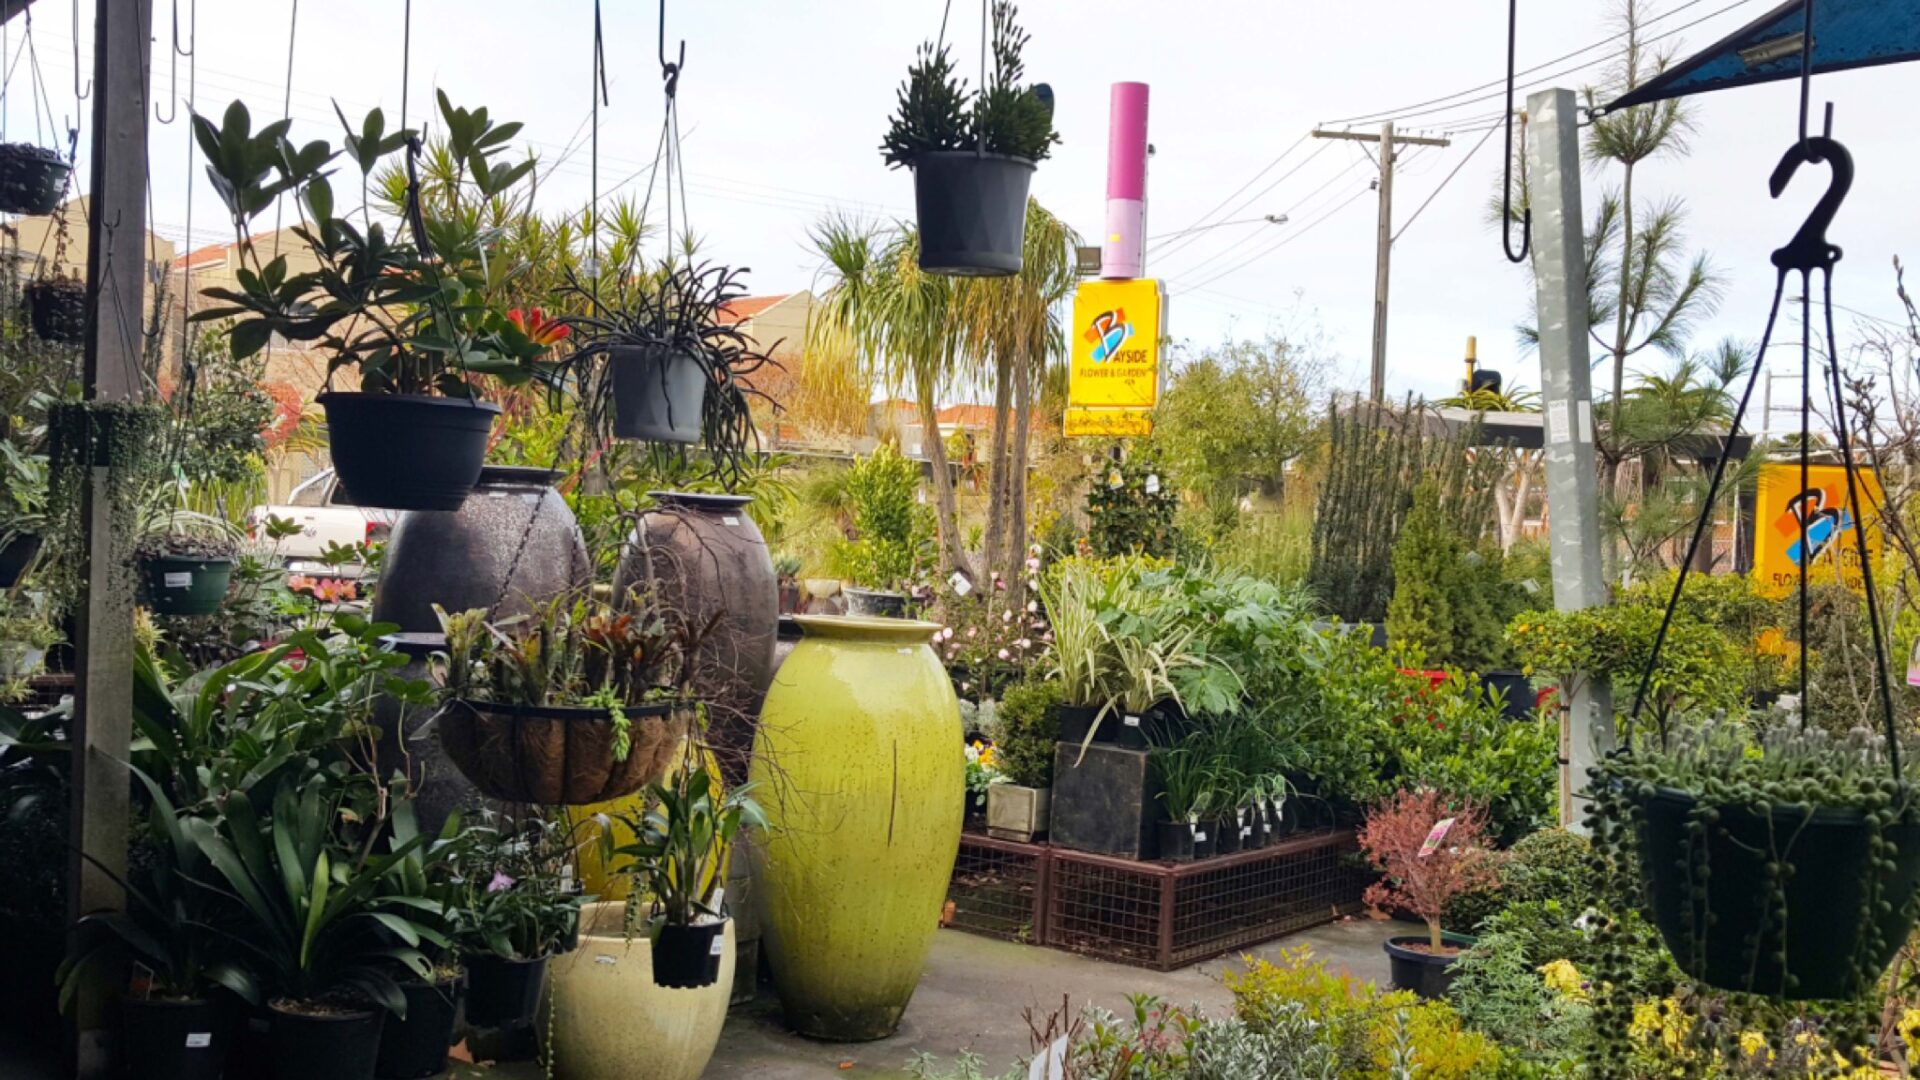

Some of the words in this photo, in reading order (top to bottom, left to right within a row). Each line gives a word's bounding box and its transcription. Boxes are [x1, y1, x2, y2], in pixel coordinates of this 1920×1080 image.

[1092, 310, 1147, 363] BAYSIDE
[1080, 368, 1108, 378] FLOWER
[1117, 368, 1147, 378] GARDEN
